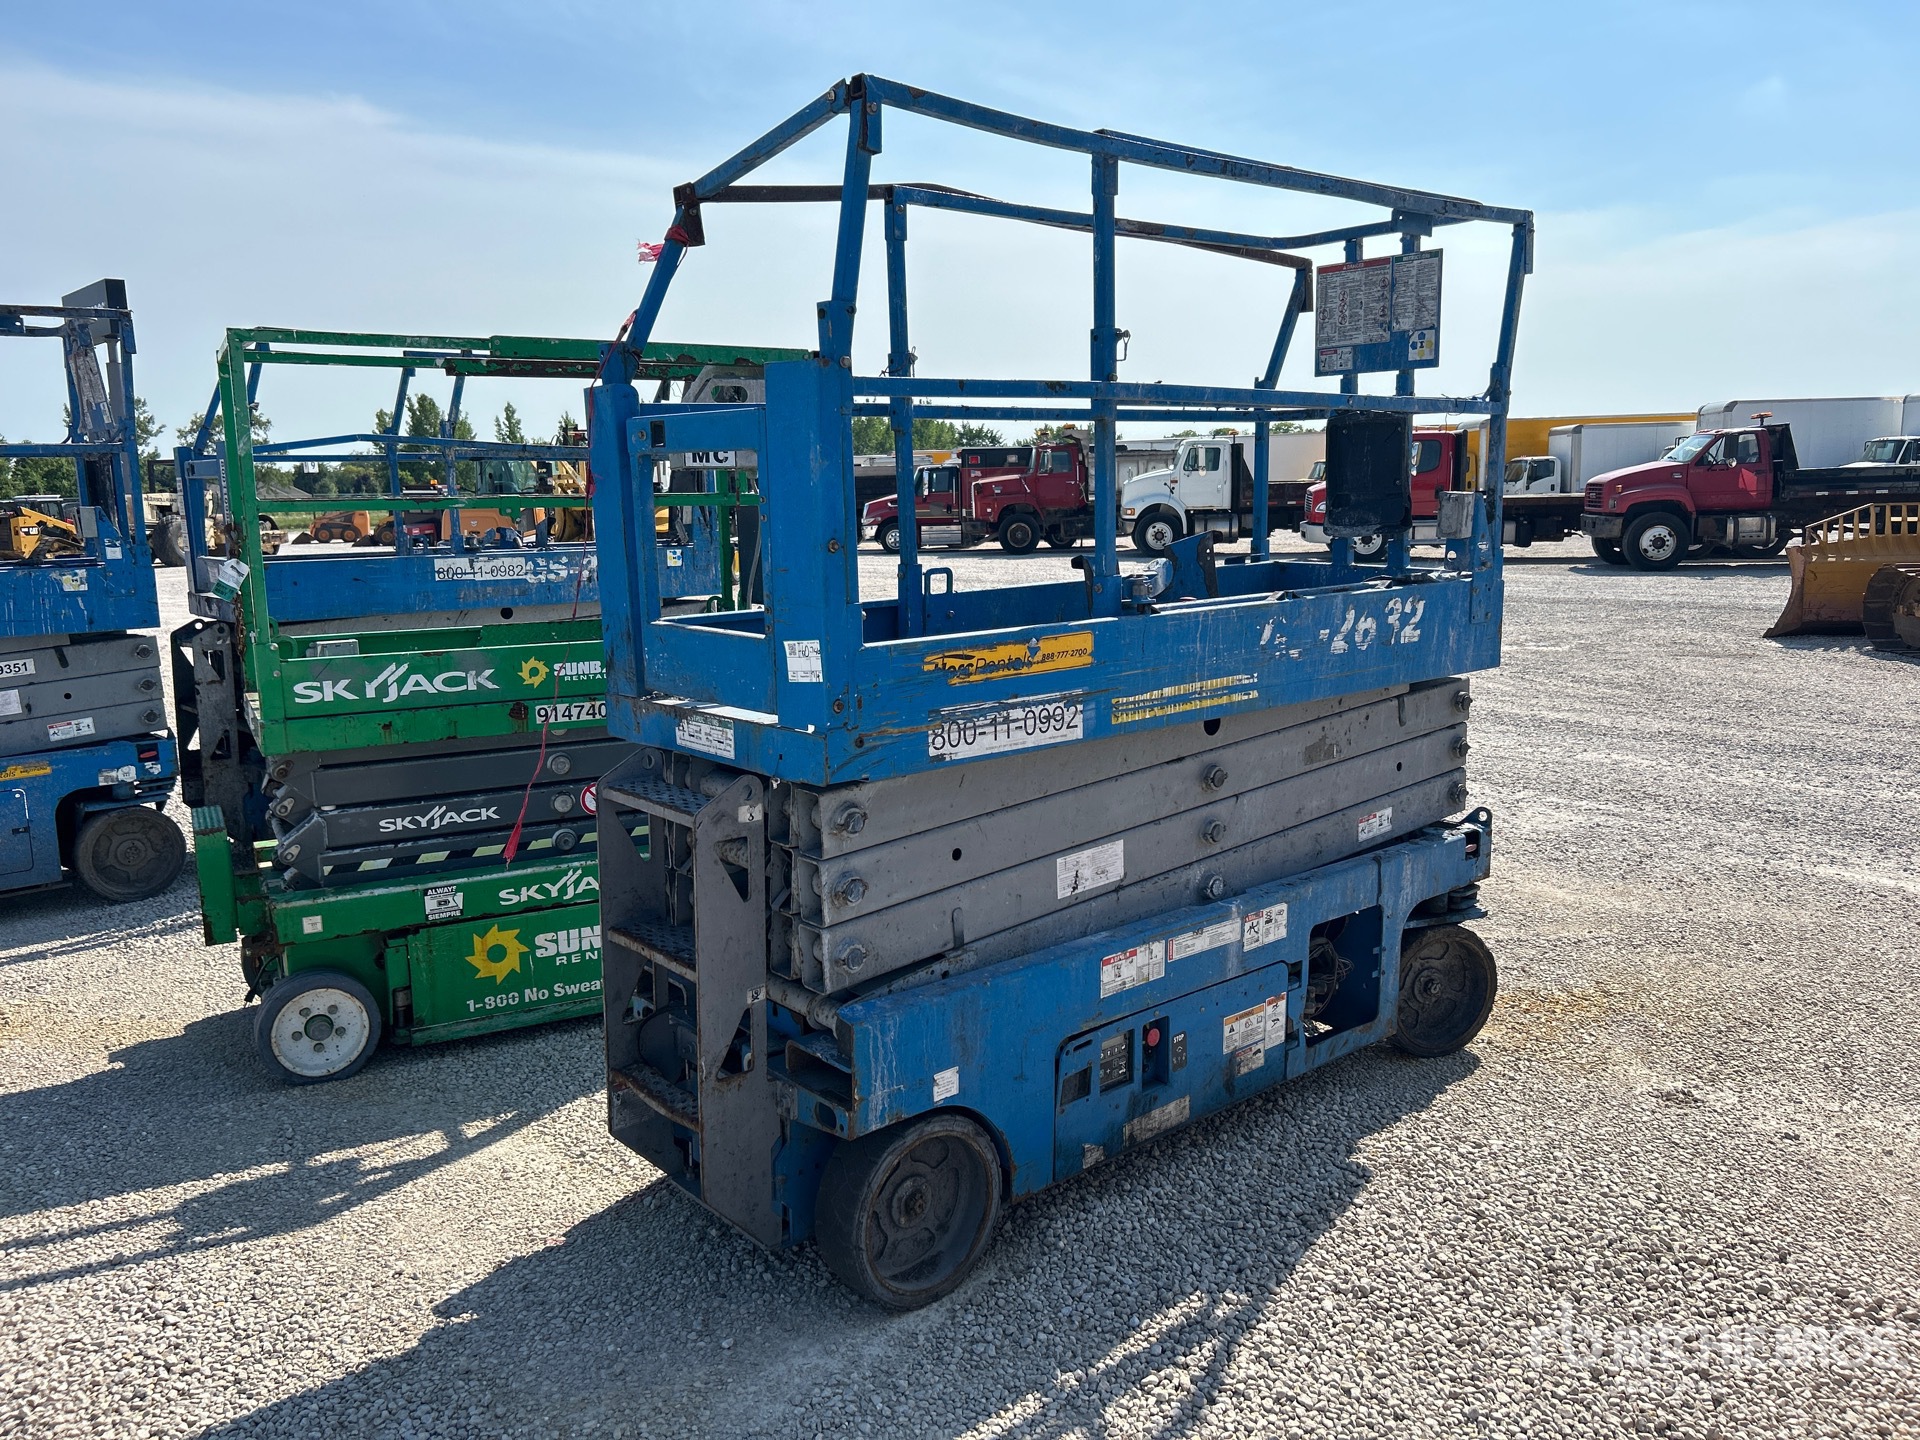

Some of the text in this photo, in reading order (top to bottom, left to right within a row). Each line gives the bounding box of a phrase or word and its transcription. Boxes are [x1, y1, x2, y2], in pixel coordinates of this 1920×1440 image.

[436, 564, 524, 580] 800-11-0982
[293, 662, 500, 703] SKYJACK
[932, 704, 1079, 751] 800-11-0992
[379, 805, 500, 832] SKYJACK
[428, 910, 461, 921] SIEMPRE
[466, 979, 603, 1012] 1-800 No Swea
[1173, 1033, 1185, 1044] STOP
